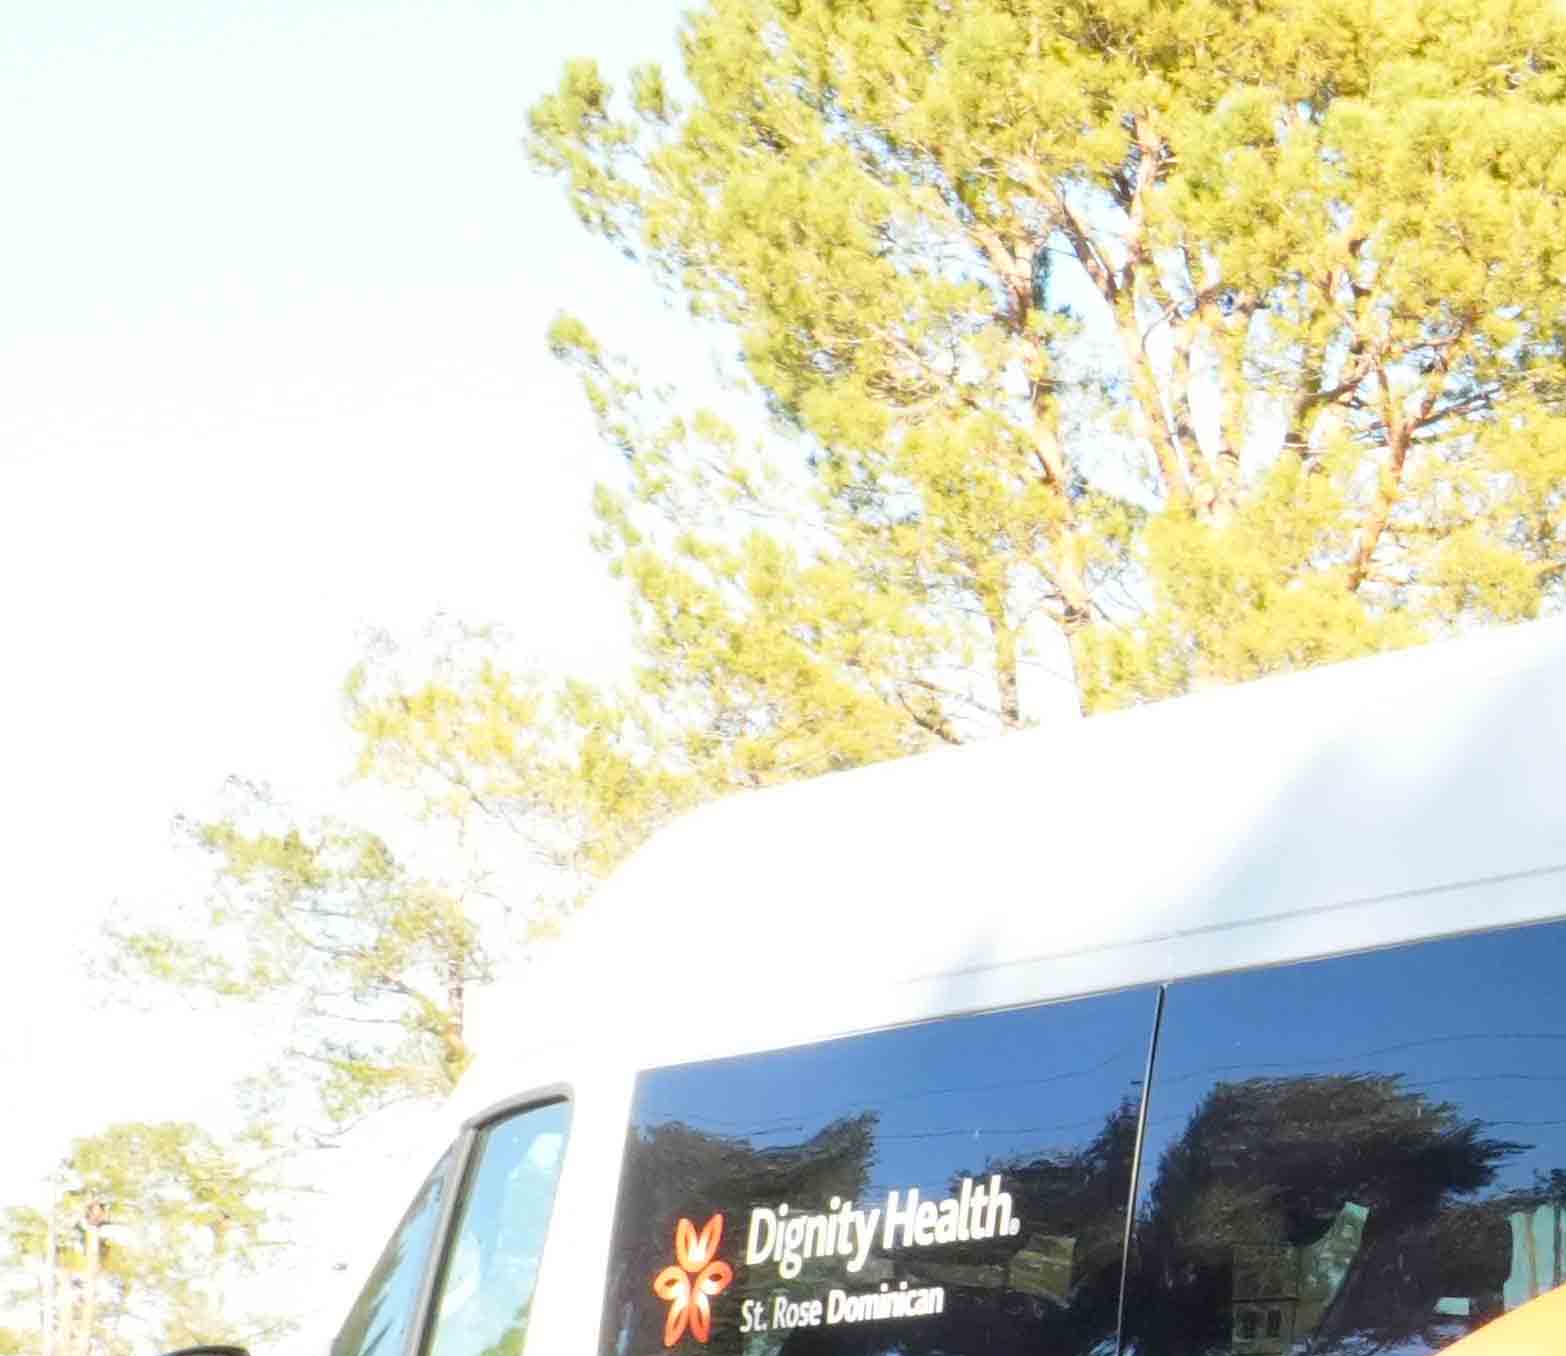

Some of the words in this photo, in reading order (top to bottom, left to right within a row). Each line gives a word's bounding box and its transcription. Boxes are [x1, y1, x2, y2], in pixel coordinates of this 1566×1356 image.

[745, 1196, 880, 1280] Dignity
[740, 1299, 768, 1334] St.
[773, 1294, 822, 1331] Rose
[827, 1283, 945, 1326] Dominican
